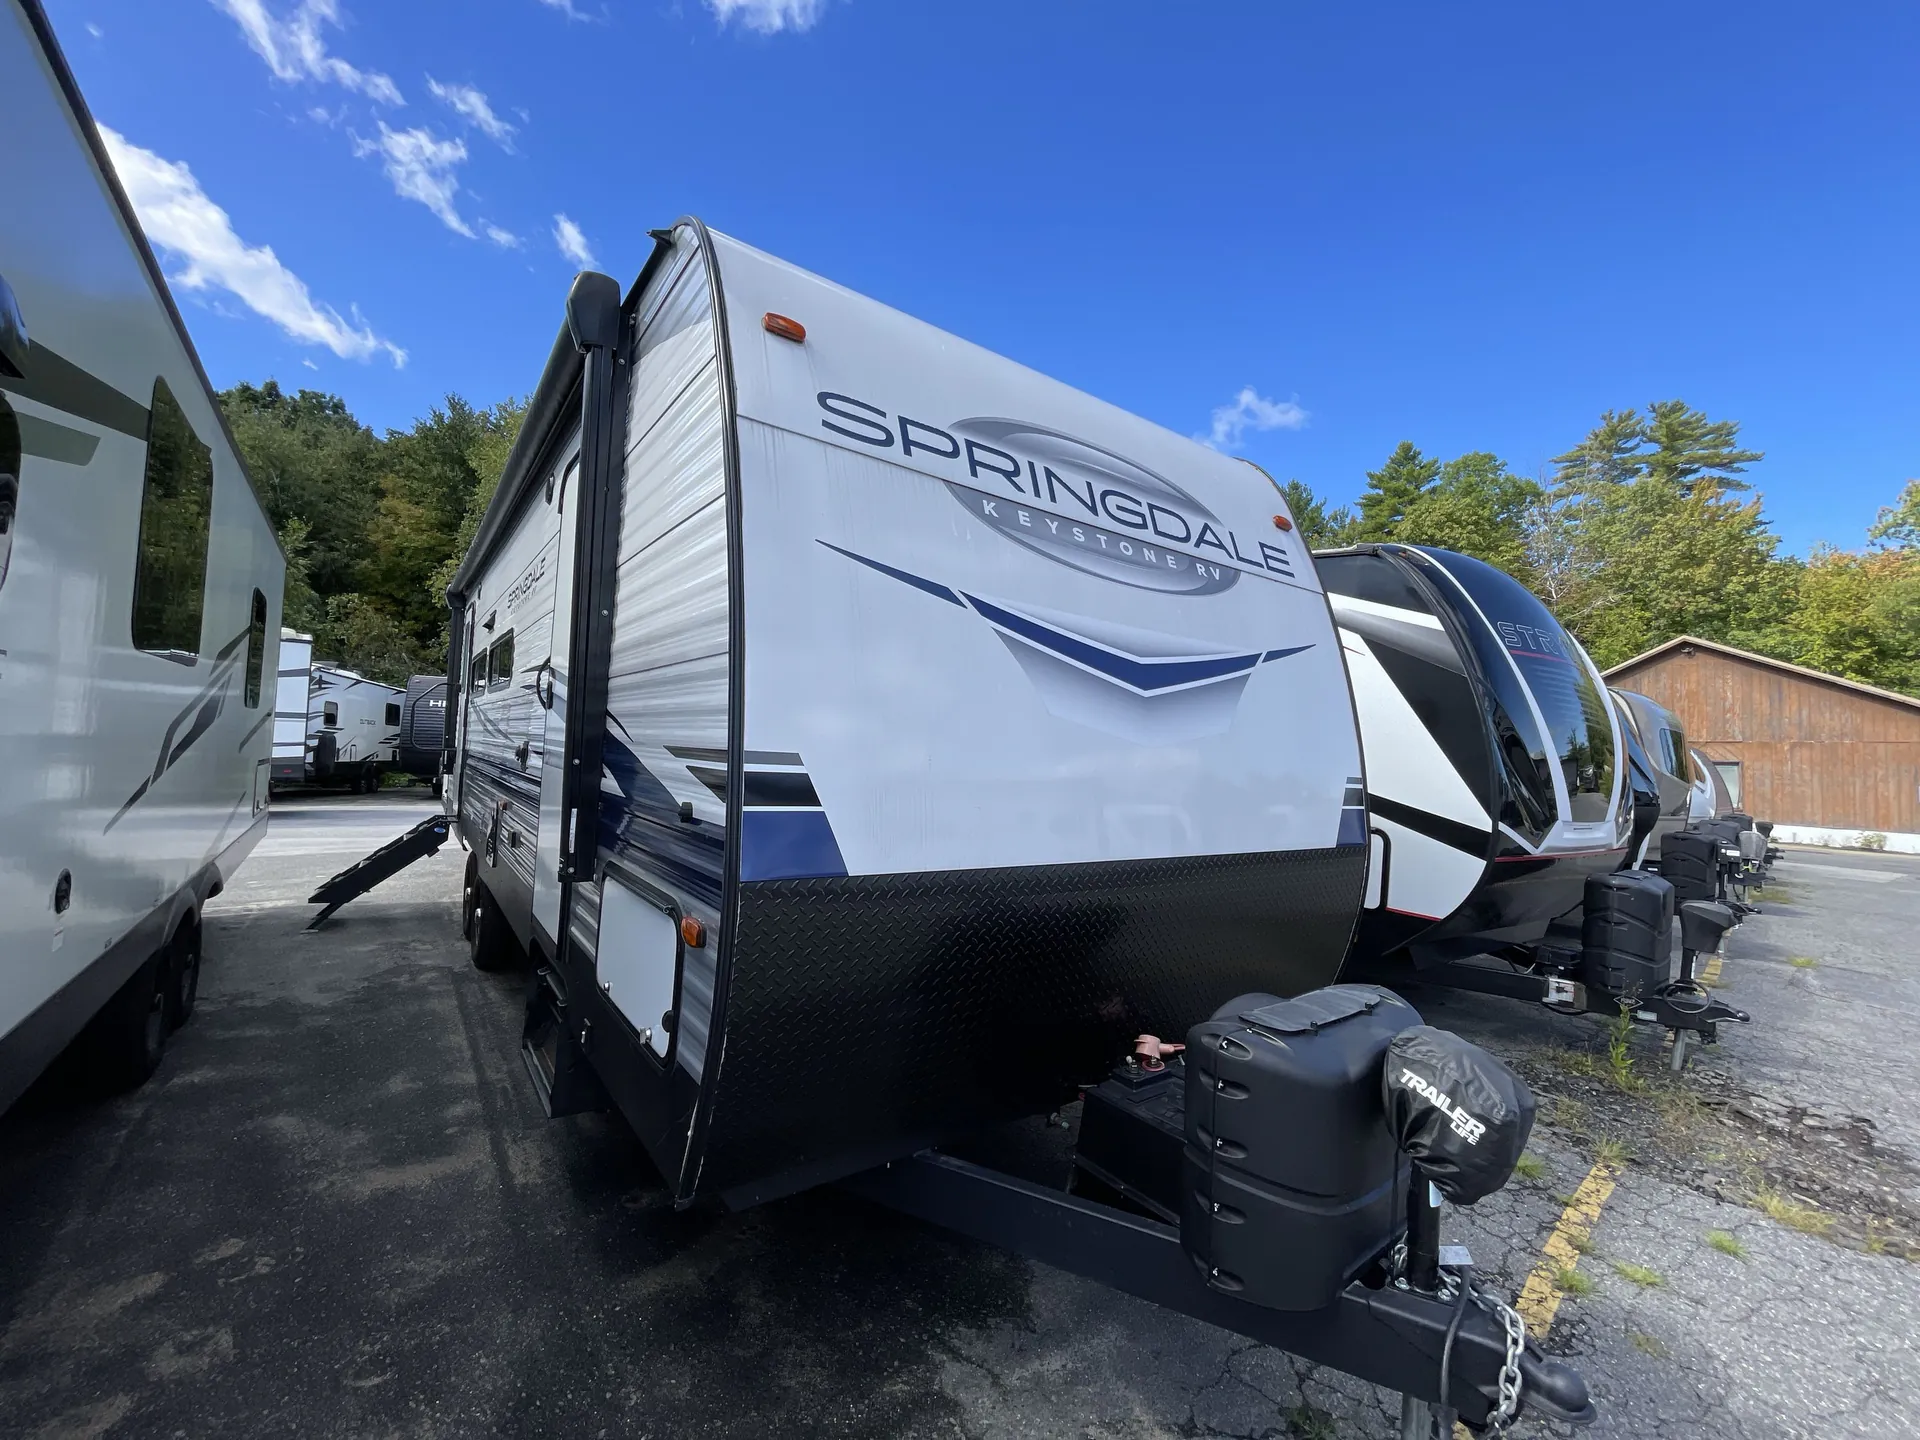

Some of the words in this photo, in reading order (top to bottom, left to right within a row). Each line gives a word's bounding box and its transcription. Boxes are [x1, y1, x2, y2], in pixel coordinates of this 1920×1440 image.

[816, 391, 1295, 578] SPRINGDALE
[983, 499, 1178, 570] KEYSTONE
[1195, 562, 1221, 581] RV
[1400, 1068, 1487, 1138] TRAILER
[1450, 1120, 1480, 1146] LIFE
